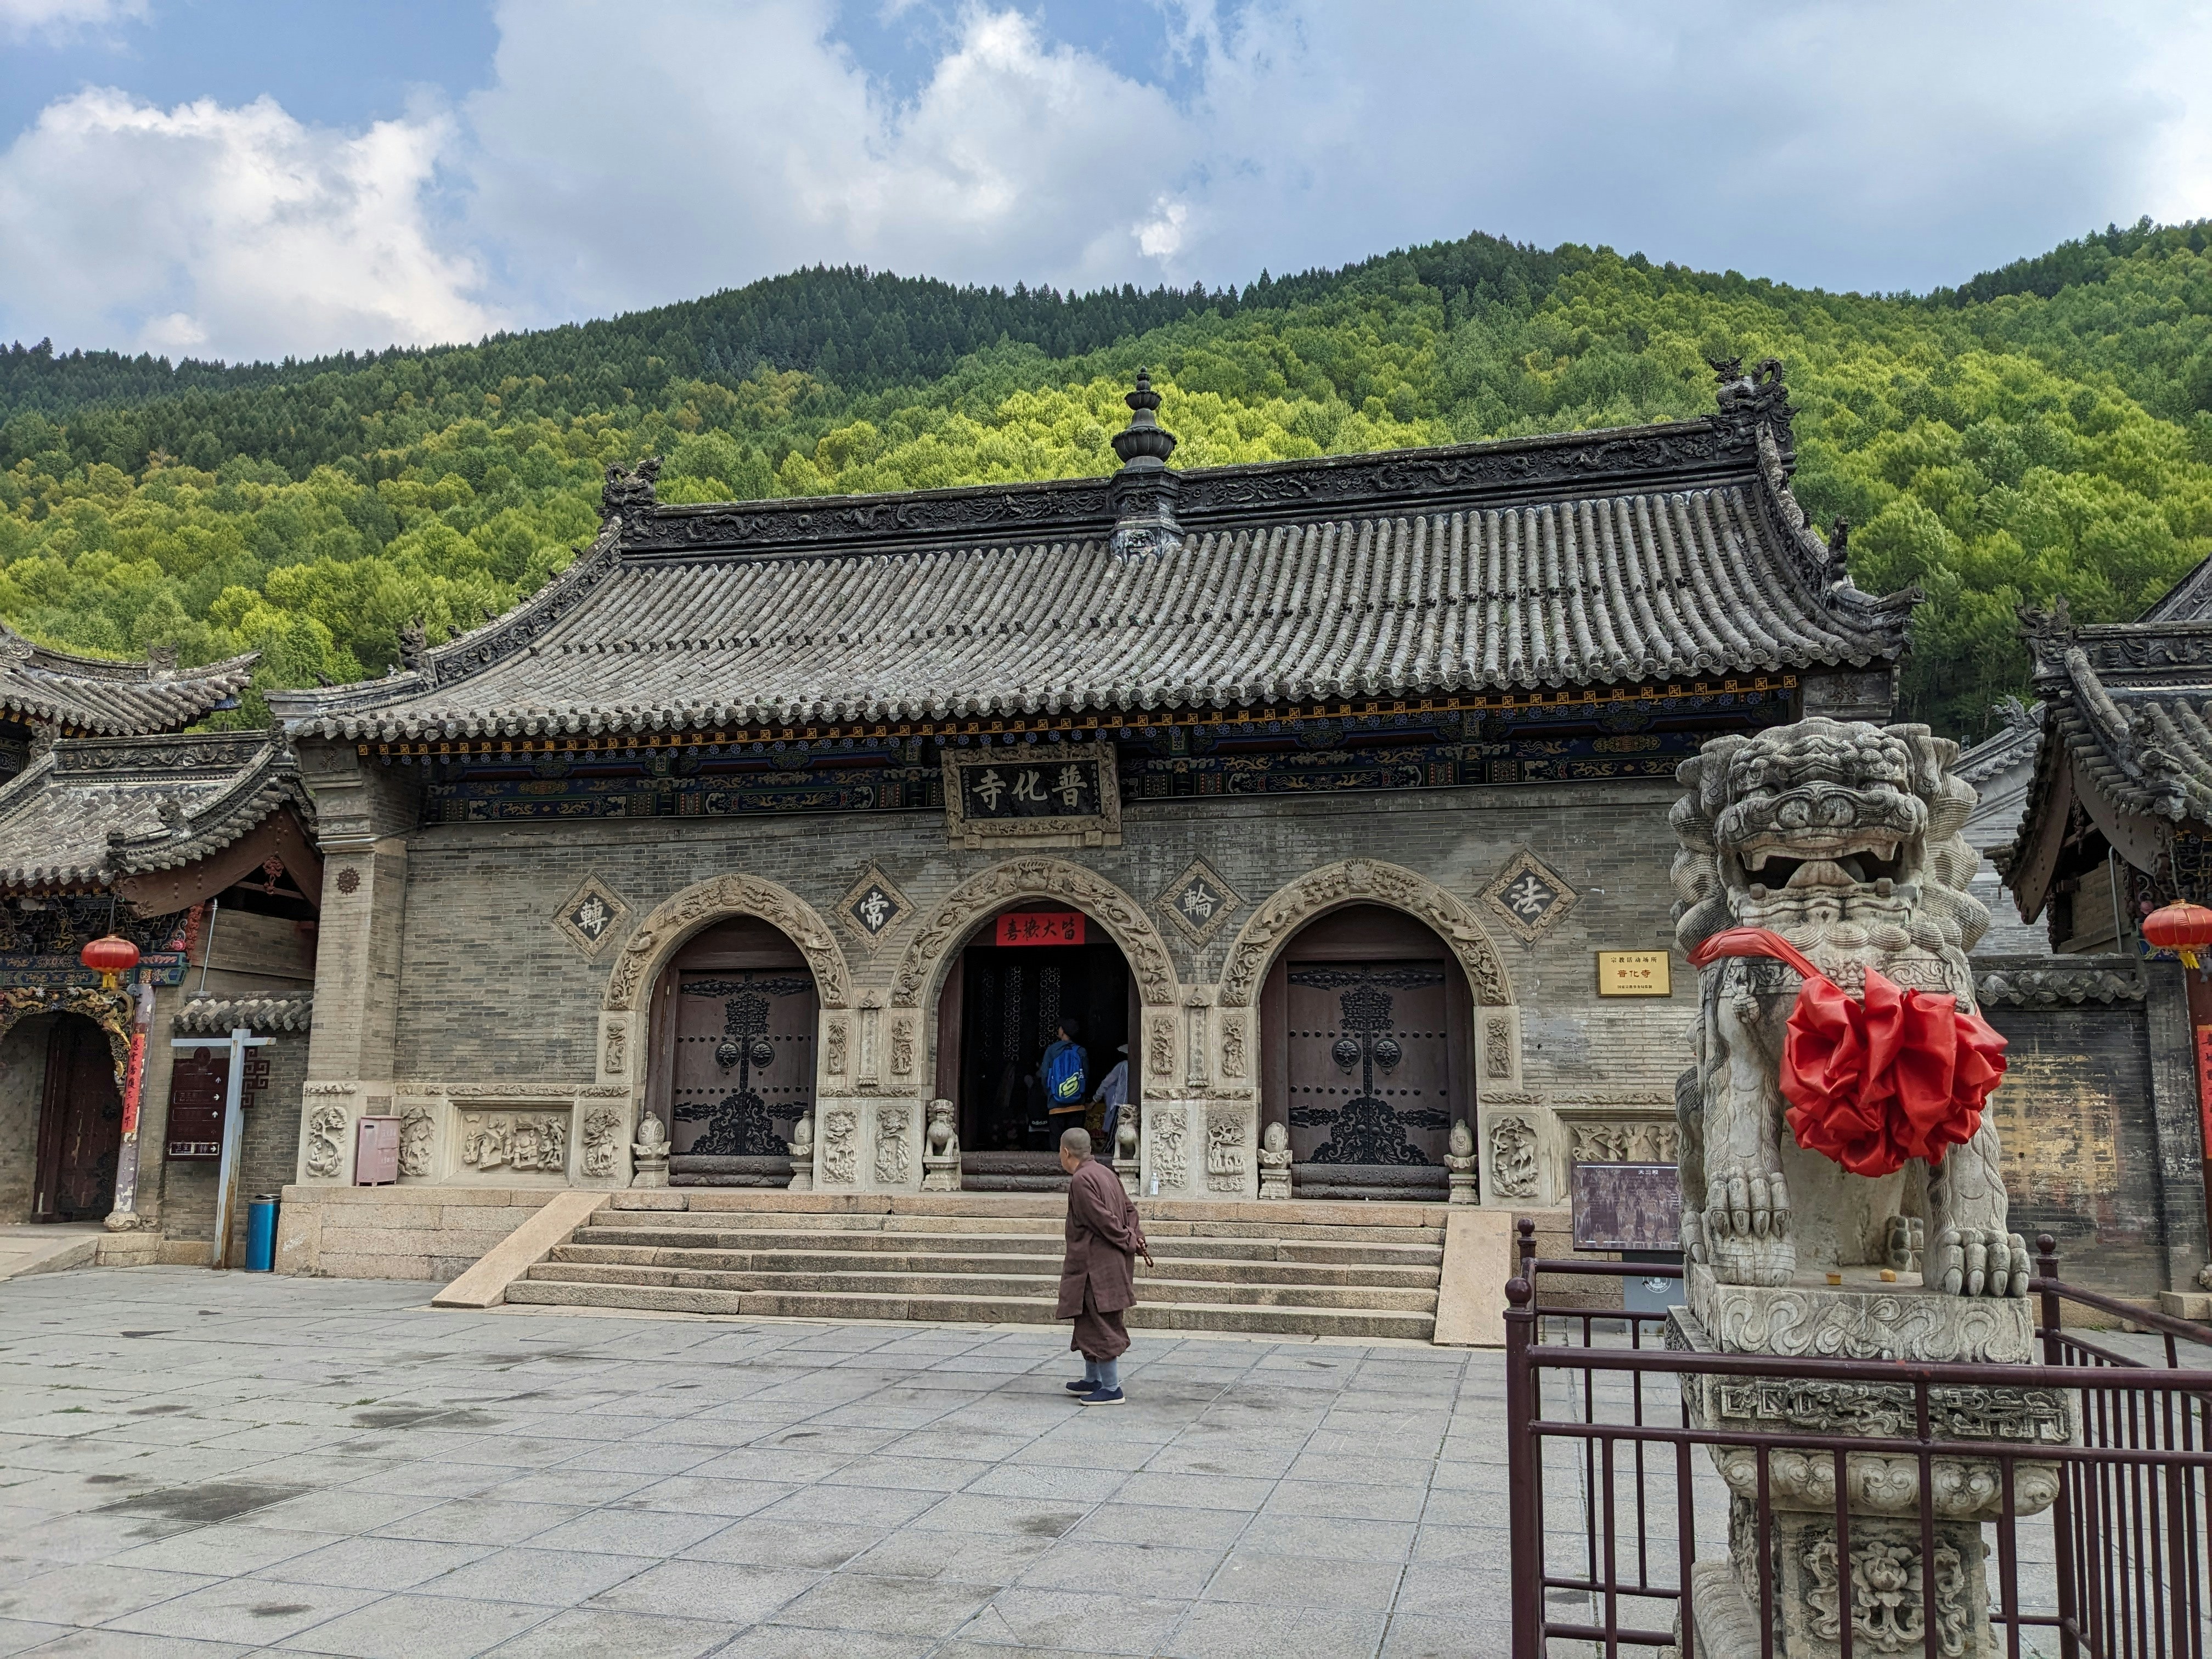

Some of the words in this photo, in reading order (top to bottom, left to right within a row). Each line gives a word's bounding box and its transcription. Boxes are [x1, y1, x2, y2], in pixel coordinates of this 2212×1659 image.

[972, 764, 1087, 811] 普化寺
[860, 891, 889, 930] 常
[1183, 883, 1218, 918] 輪
[1510, 876, 1550, 914] 法
[578, 897, 608, 935] 轉
[1617, 969, 1651, 978] 普化寺
